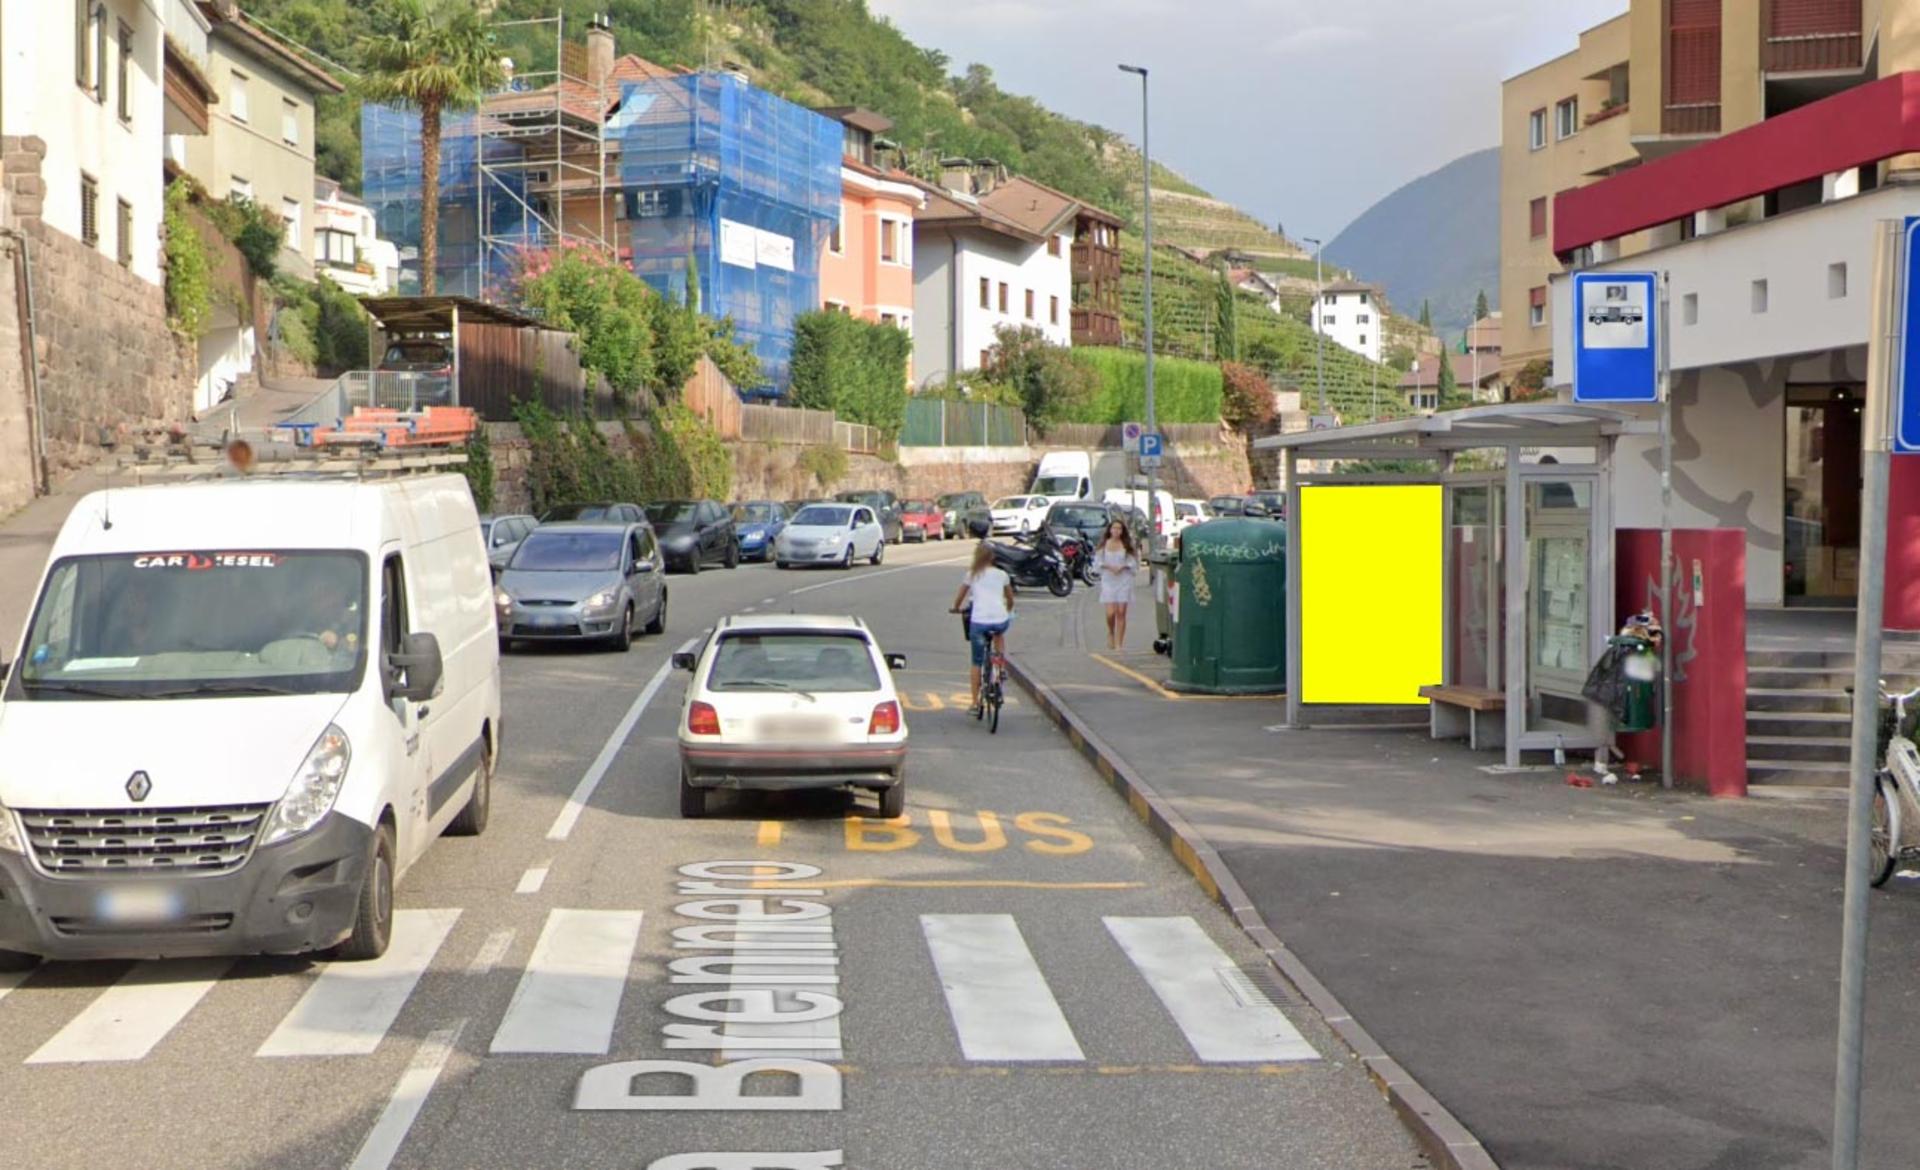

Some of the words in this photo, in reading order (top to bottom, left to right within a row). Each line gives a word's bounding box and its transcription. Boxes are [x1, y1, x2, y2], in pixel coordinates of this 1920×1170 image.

[1144, 436, 1157, 454] P
[134, 555, 183, 568] CAR
[845, 810, 1094, 855] BUS
